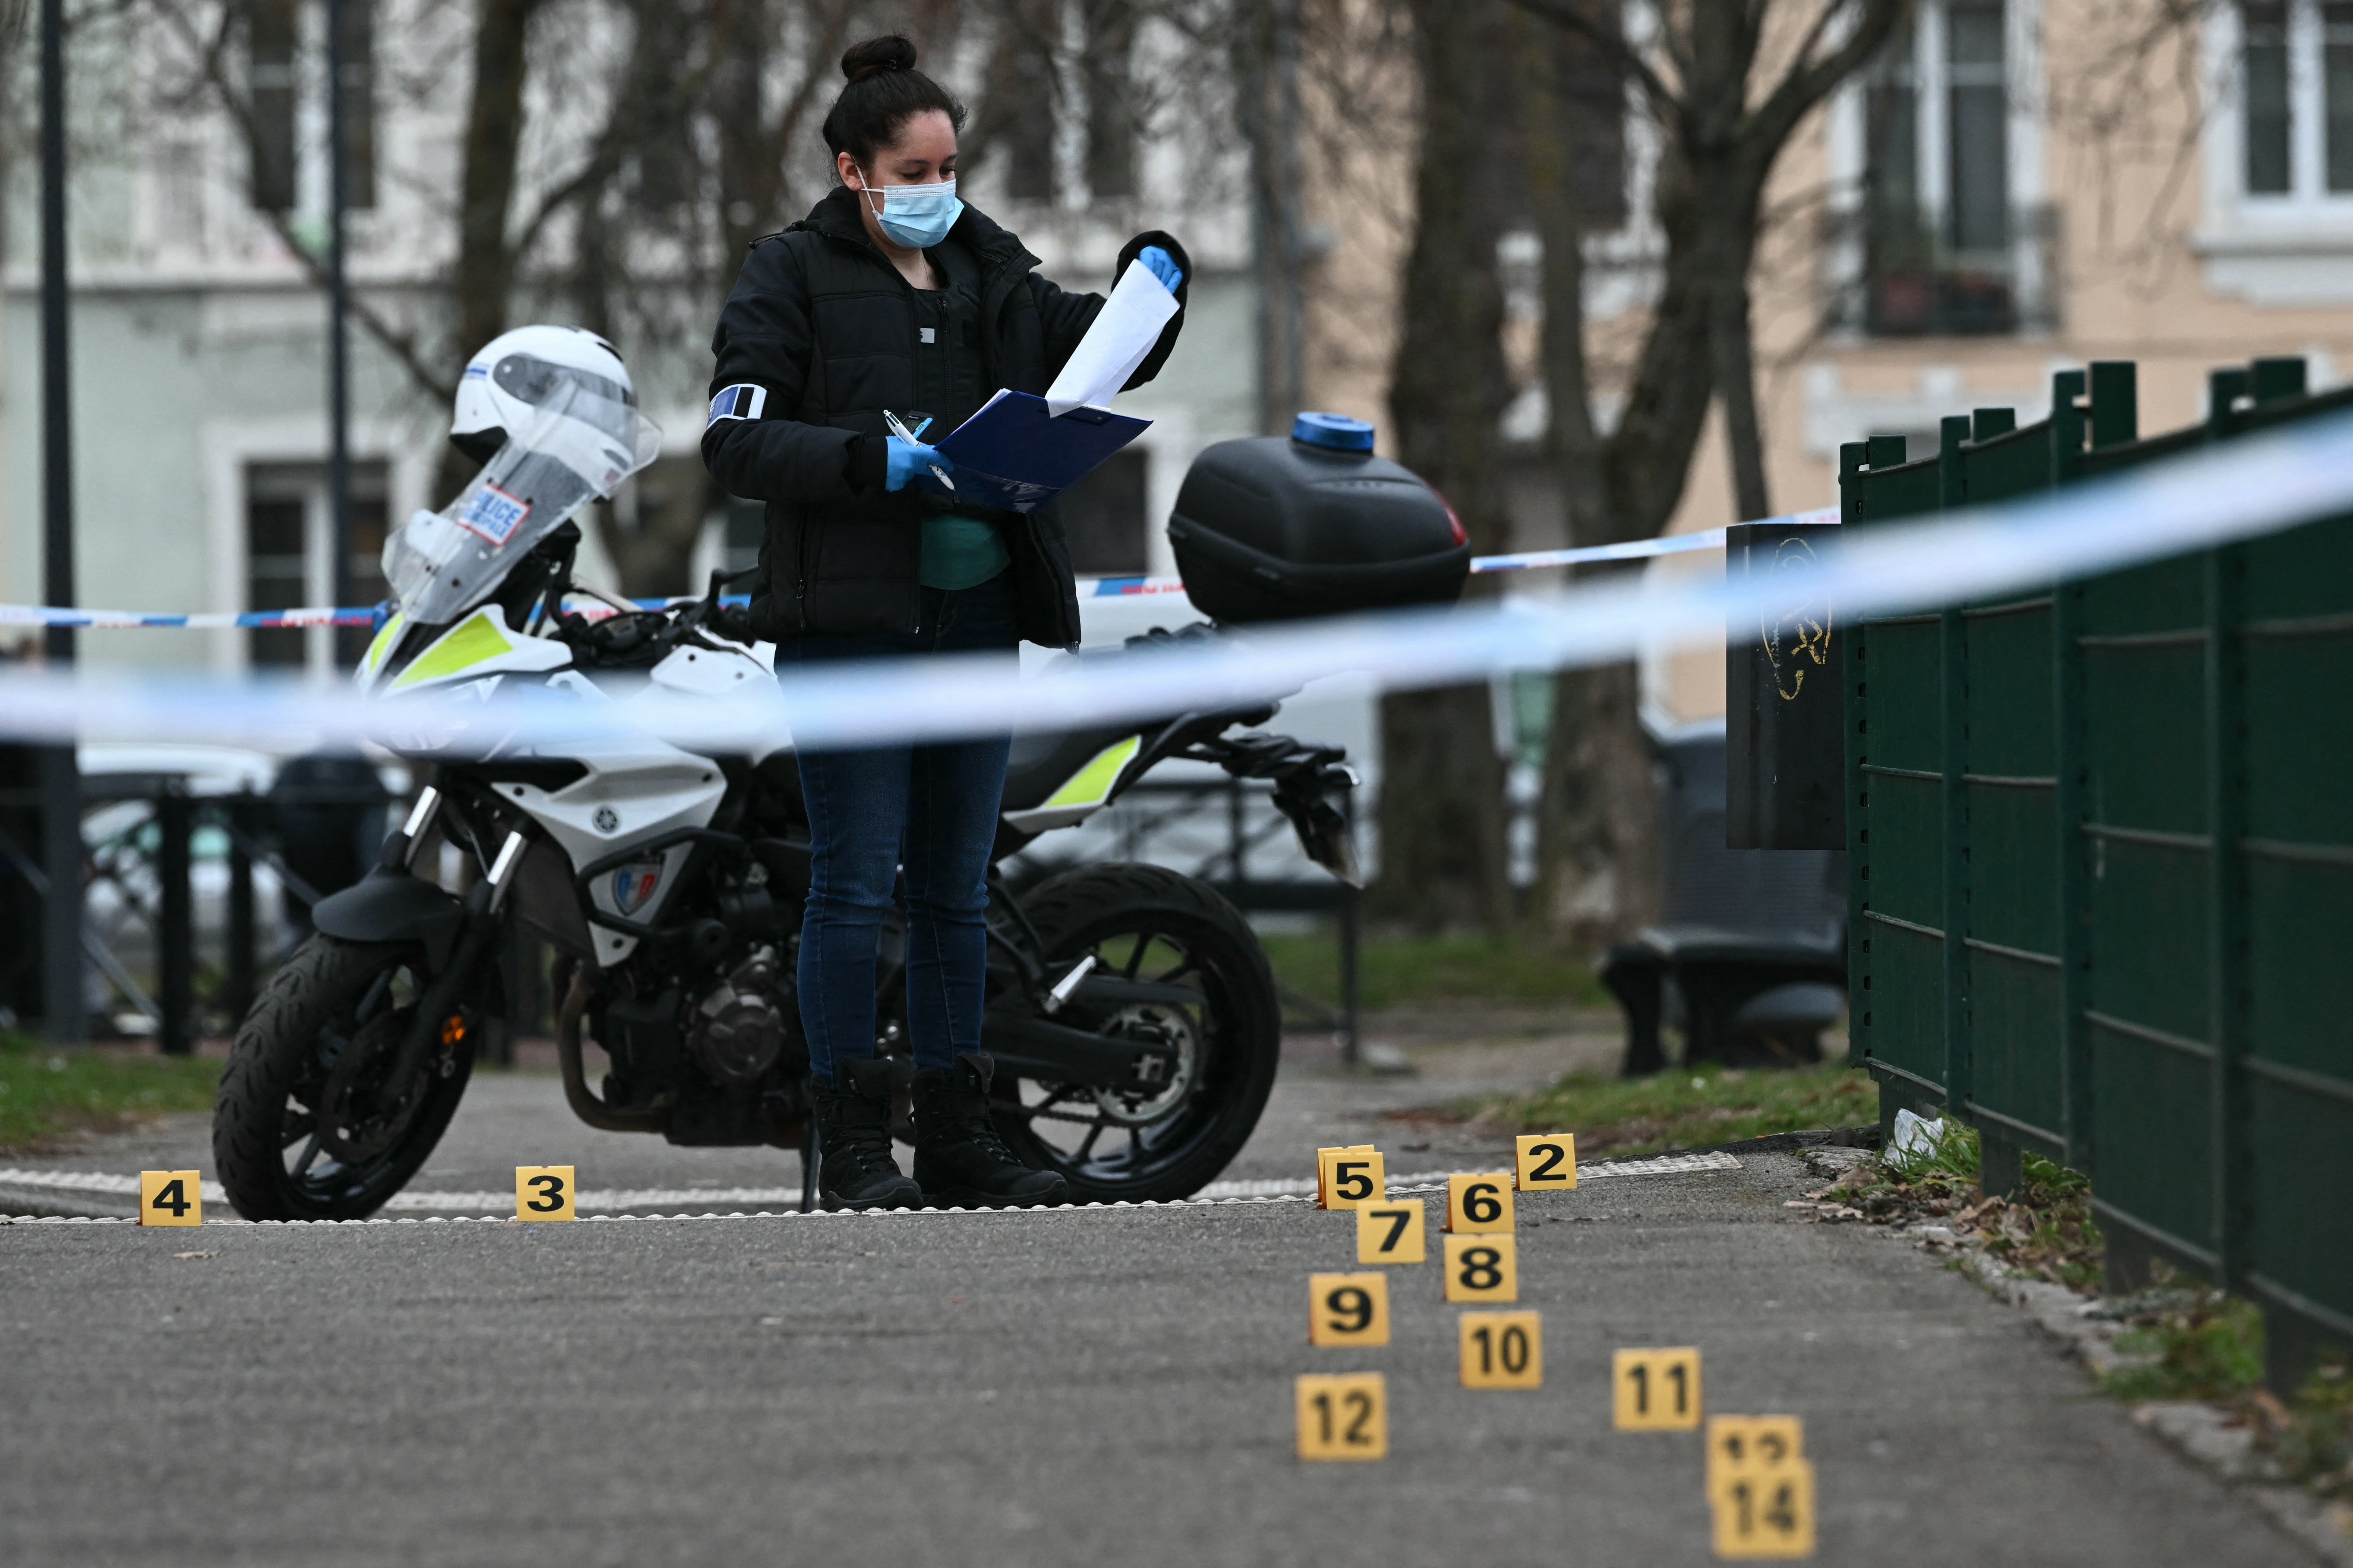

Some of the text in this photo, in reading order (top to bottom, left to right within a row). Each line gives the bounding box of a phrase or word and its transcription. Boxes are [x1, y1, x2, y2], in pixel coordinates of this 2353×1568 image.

[1337, 1162, 1373, 1199] 5
[1529, 1144, 1566, 1181] 2
[152, 1180, 190, 1217] 4
[527, 1176, 564, 1212] 3
[1463, 1183, 1501, 1223] 6
[1370, 1210, 1410, 1252] 7
[1459, 1248, 1502, 1290] 8
[1327, 1287, 1373, 1334] 9
[1471, 1325, 1530, 1376] 10
[1627, 1362, 1689, 1417] 11
[1311, 1389, 1374, 1447] 12
[1730, 1480, 1798, 1537] 14
